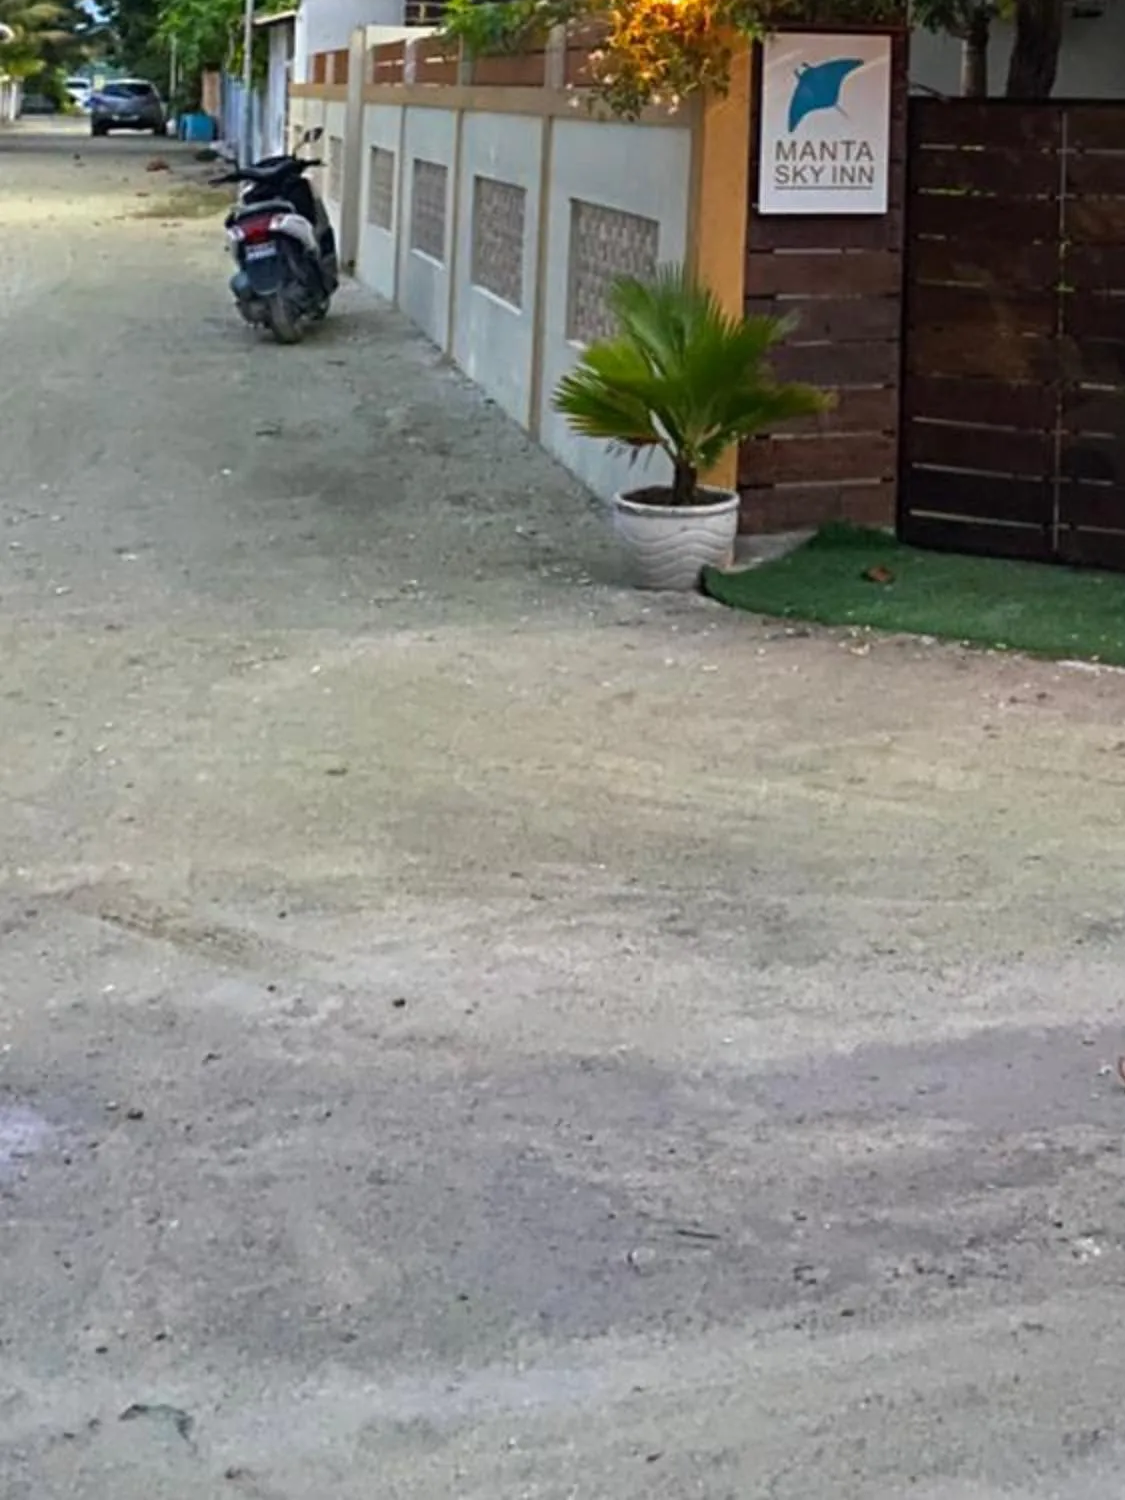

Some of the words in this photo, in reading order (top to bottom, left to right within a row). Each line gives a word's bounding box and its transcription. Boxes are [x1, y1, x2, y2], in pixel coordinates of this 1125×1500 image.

[775, 140, 873, 162] MANTA
[775, 164, 825, 184] SKY
[832, 165, 874, 184] INN
